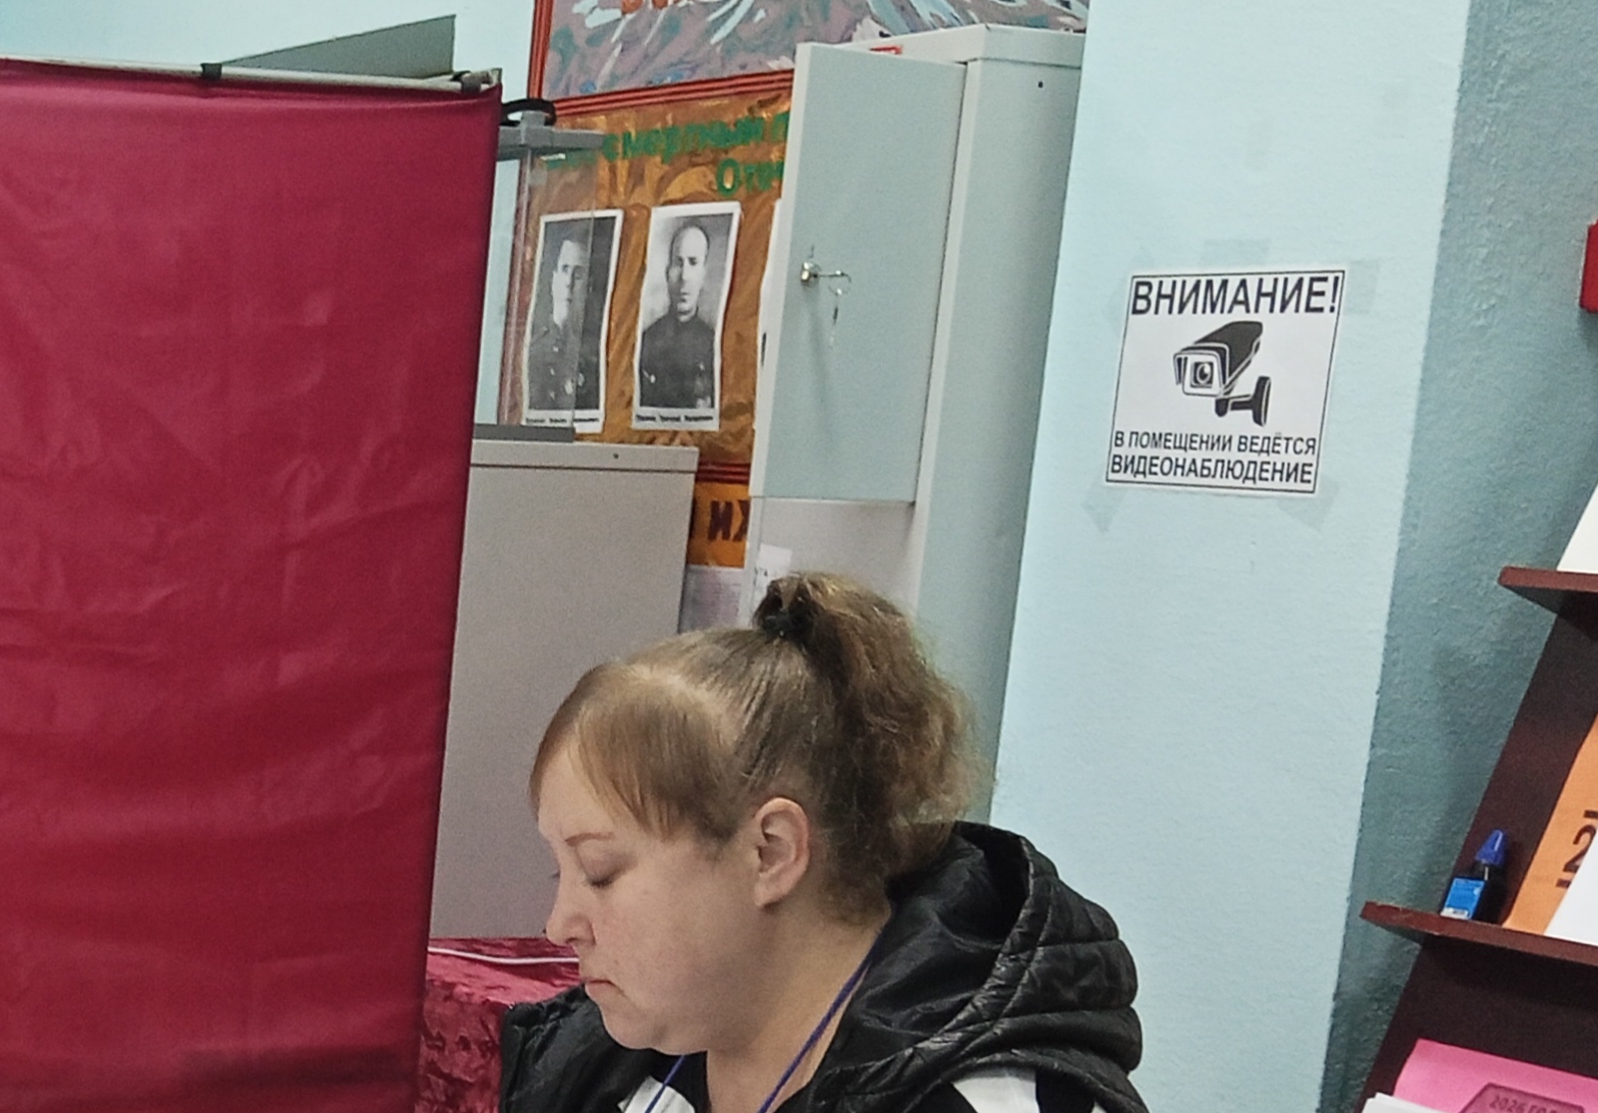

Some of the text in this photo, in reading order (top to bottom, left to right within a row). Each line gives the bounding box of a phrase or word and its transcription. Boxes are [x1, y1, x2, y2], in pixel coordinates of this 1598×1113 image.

[1131, 275, 1338, 317] ВНИМАНИЕ!
[1114, 430, 1317, 456] В ПОМЕЩЕНИИ ВЕДЁТСЯ
[1110, 454, 1314, 485] ВИДЕОНАБЛЮДЕНИЕ
